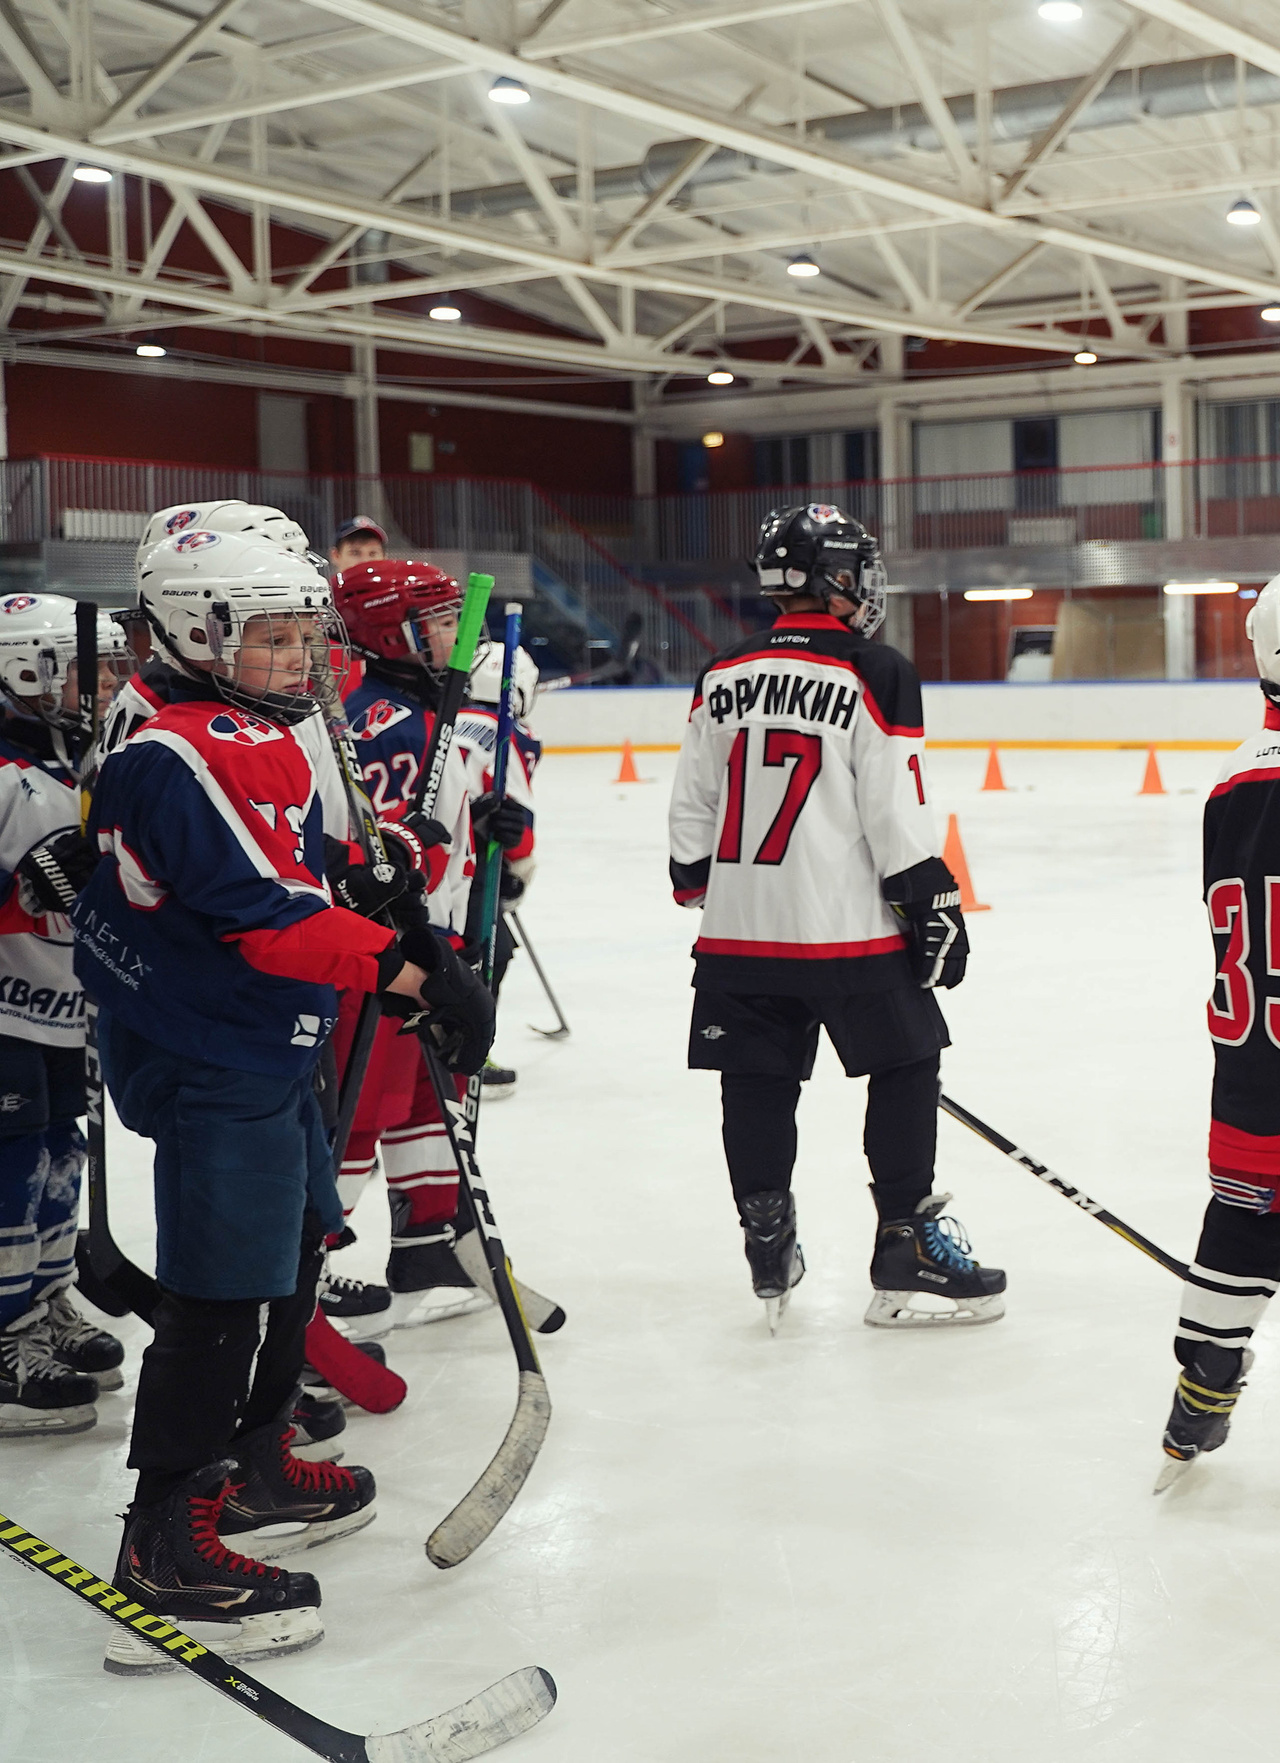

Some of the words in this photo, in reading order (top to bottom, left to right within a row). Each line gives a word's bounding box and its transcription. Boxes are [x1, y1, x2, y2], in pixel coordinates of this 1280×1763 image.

[161, 589, 199, 597] BAUER
[363, 593, 400, 609] BAUER
[770, 635, 810, 644] LUTCH
[709, 673, 858, 730] ФРУМКИН
[363, 752, 420, 813] 22
[716, 727, 823, 866] 17
[445, 1098, 502, 1242] CCM
[1008, 1147, 1104, 1216] CCM
